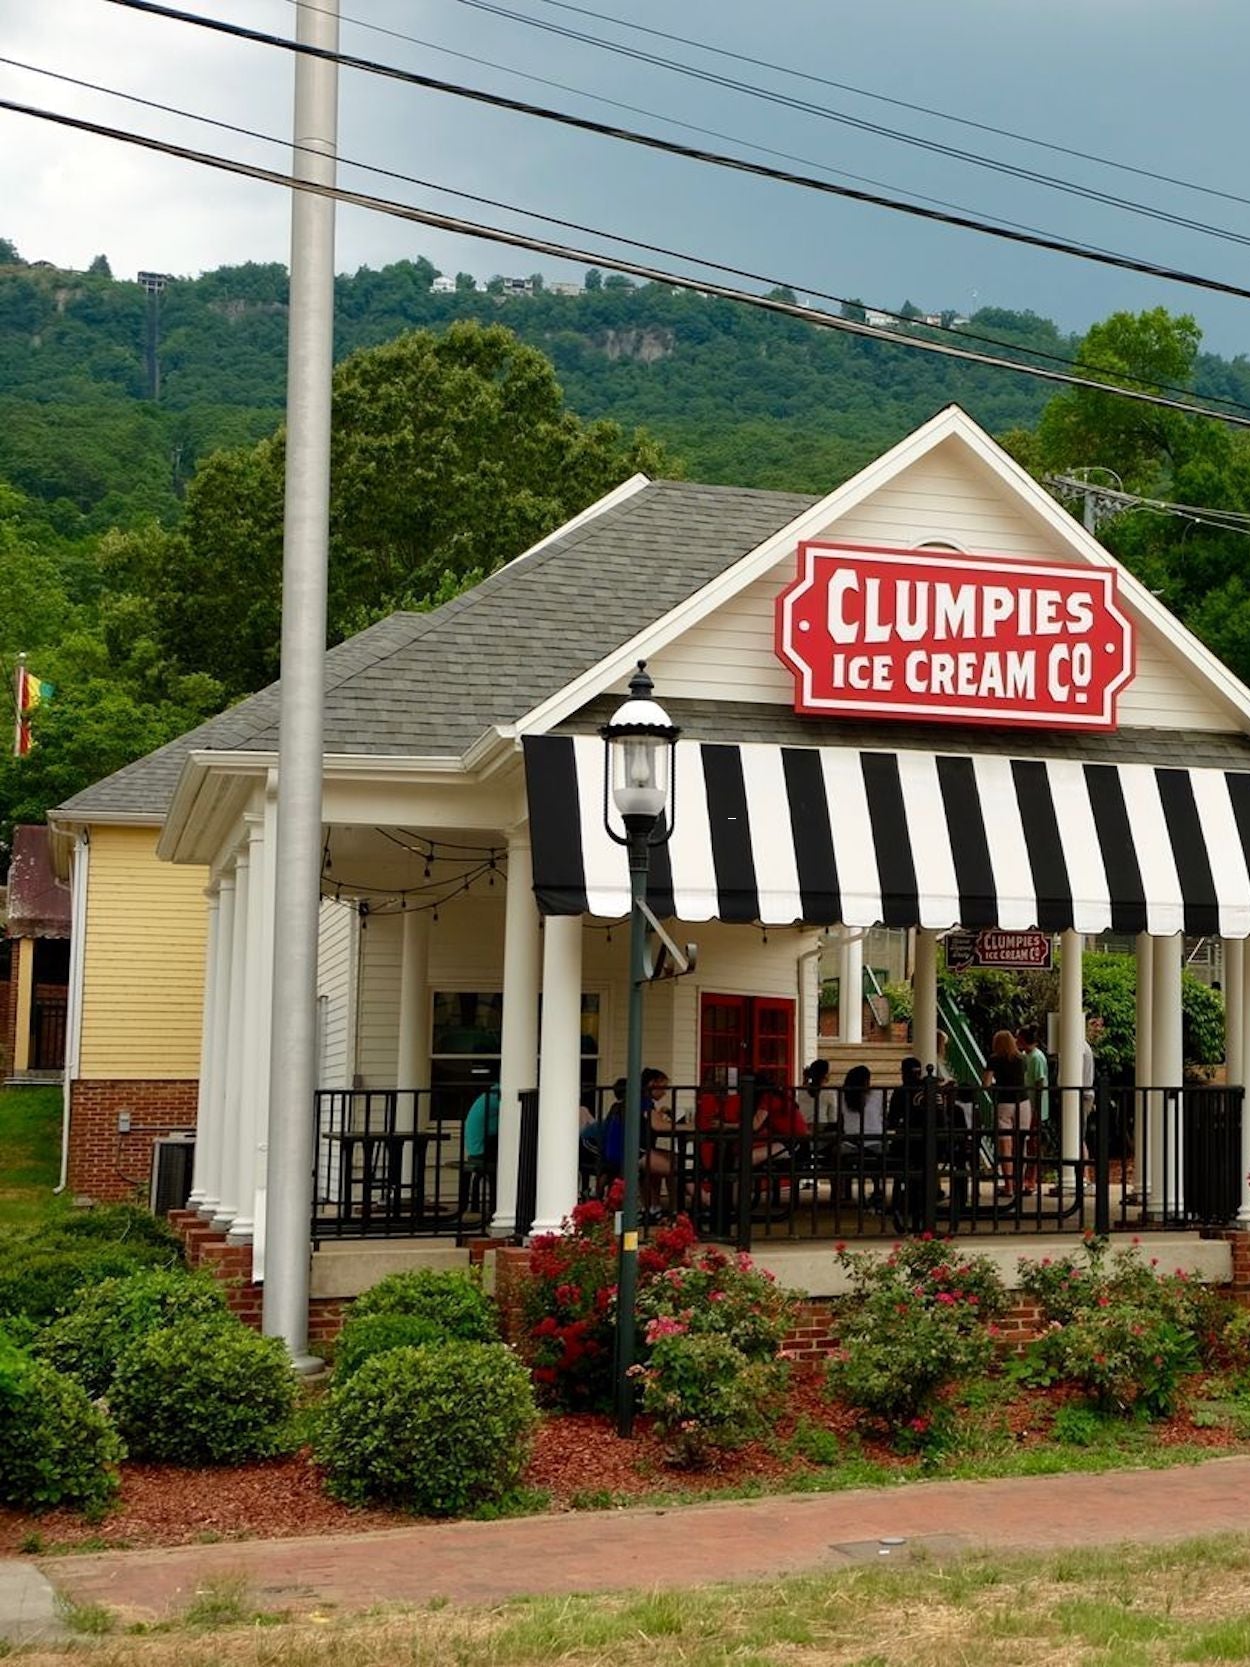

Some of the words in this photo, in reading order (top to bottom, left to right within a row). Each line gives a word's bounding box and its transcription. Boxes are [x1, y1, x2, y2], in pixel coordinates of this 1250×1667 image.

[827, 568, 1094, 645] CLUMPIES
[832, 653, 894, 692] ICE
[905, 650, 1036, 701] CREAM
[983, 932, 1040, 950] CLUMPIES
[985, 951, 998, 960] ICE
[1000, 949, 1029, 961] CREAM
